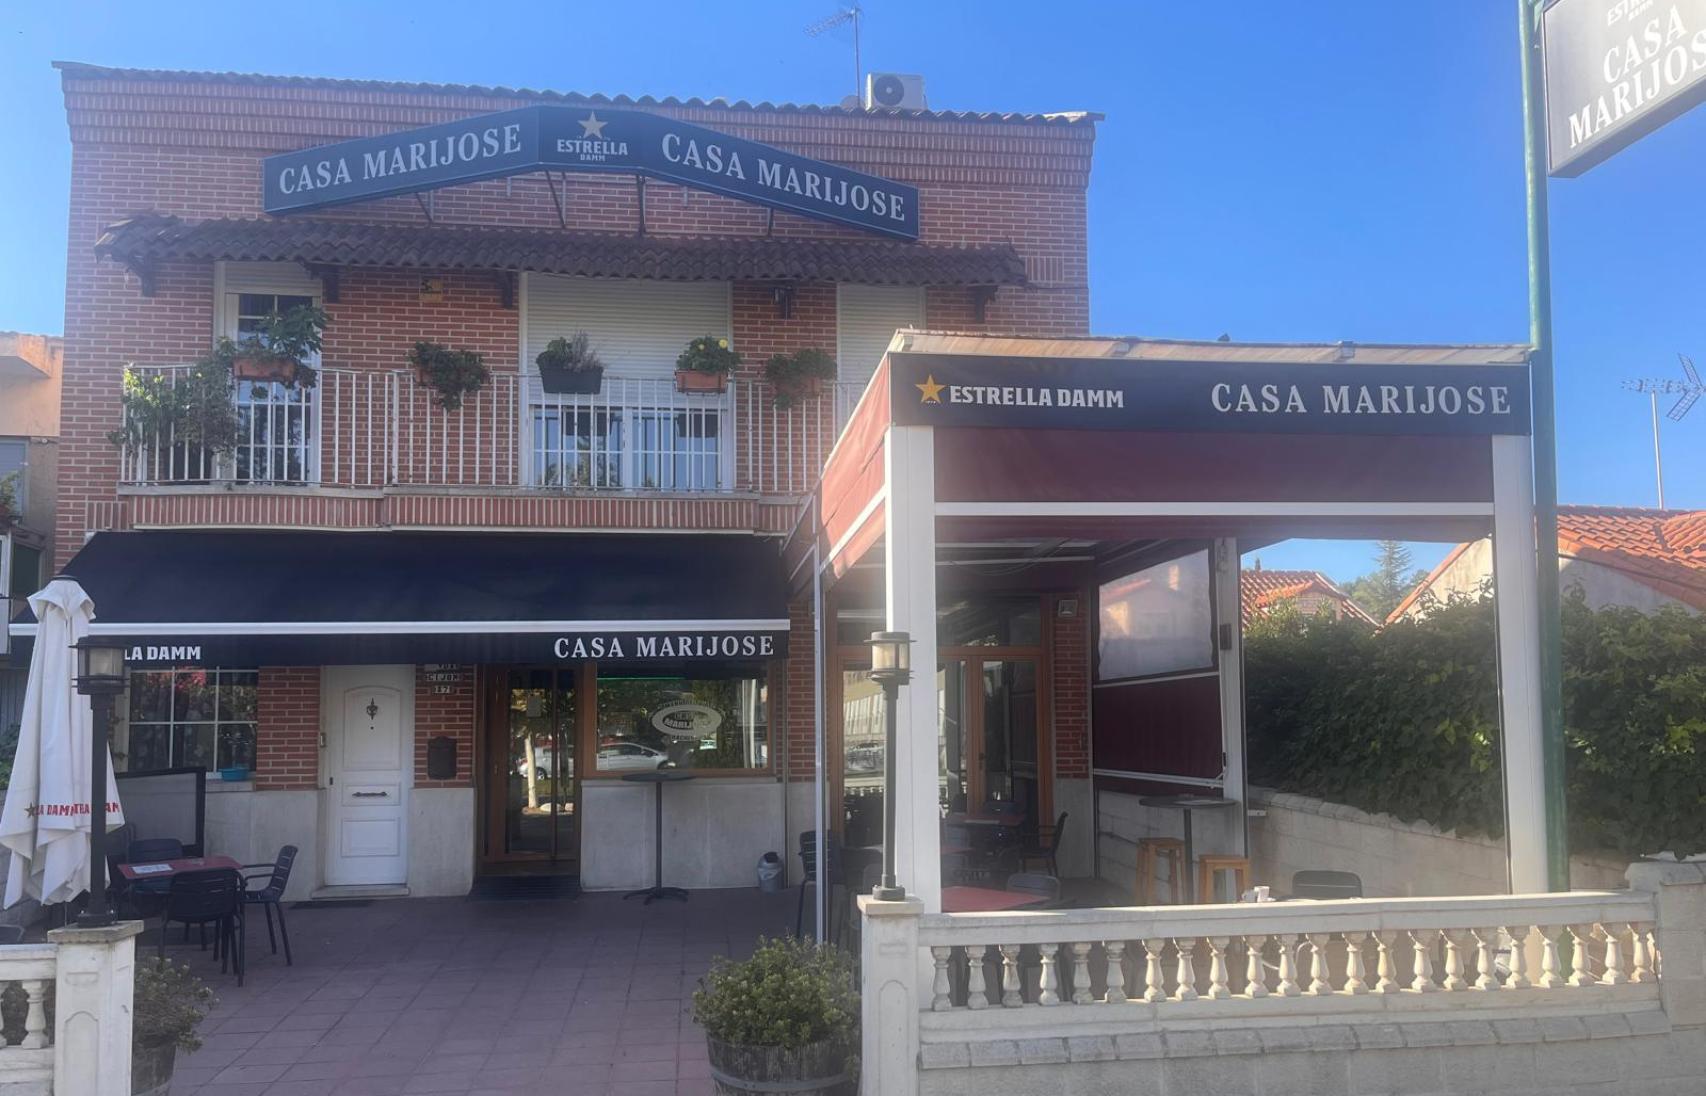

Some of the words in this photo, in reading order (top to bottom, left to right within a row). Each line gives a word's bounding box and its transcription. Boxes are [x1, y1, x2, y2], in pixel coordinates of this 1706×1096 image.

[1603, 4, 1688, 84] CASA
[279, 157, 352, 194] CASA
[363, 123, 521, 180] MARIJOSE
[557, 139, 628, 155] ESTRELLA
[661, 133, 746, 180] CASA
[757, 158, 905, 221] MARIJOSE
[950, 385, 1052, 407] ESTRELLA
[1057, 388, 1124, 408] DAMM
[1211, 383, 1307, 413] CASA
[1322, 385, 1511, 414] MARIJOSE
[146, 646, 201, 660] DAMM
[554, 637, 625, 658] CASA
[636, 635, 774, 657] MARIJOSE
